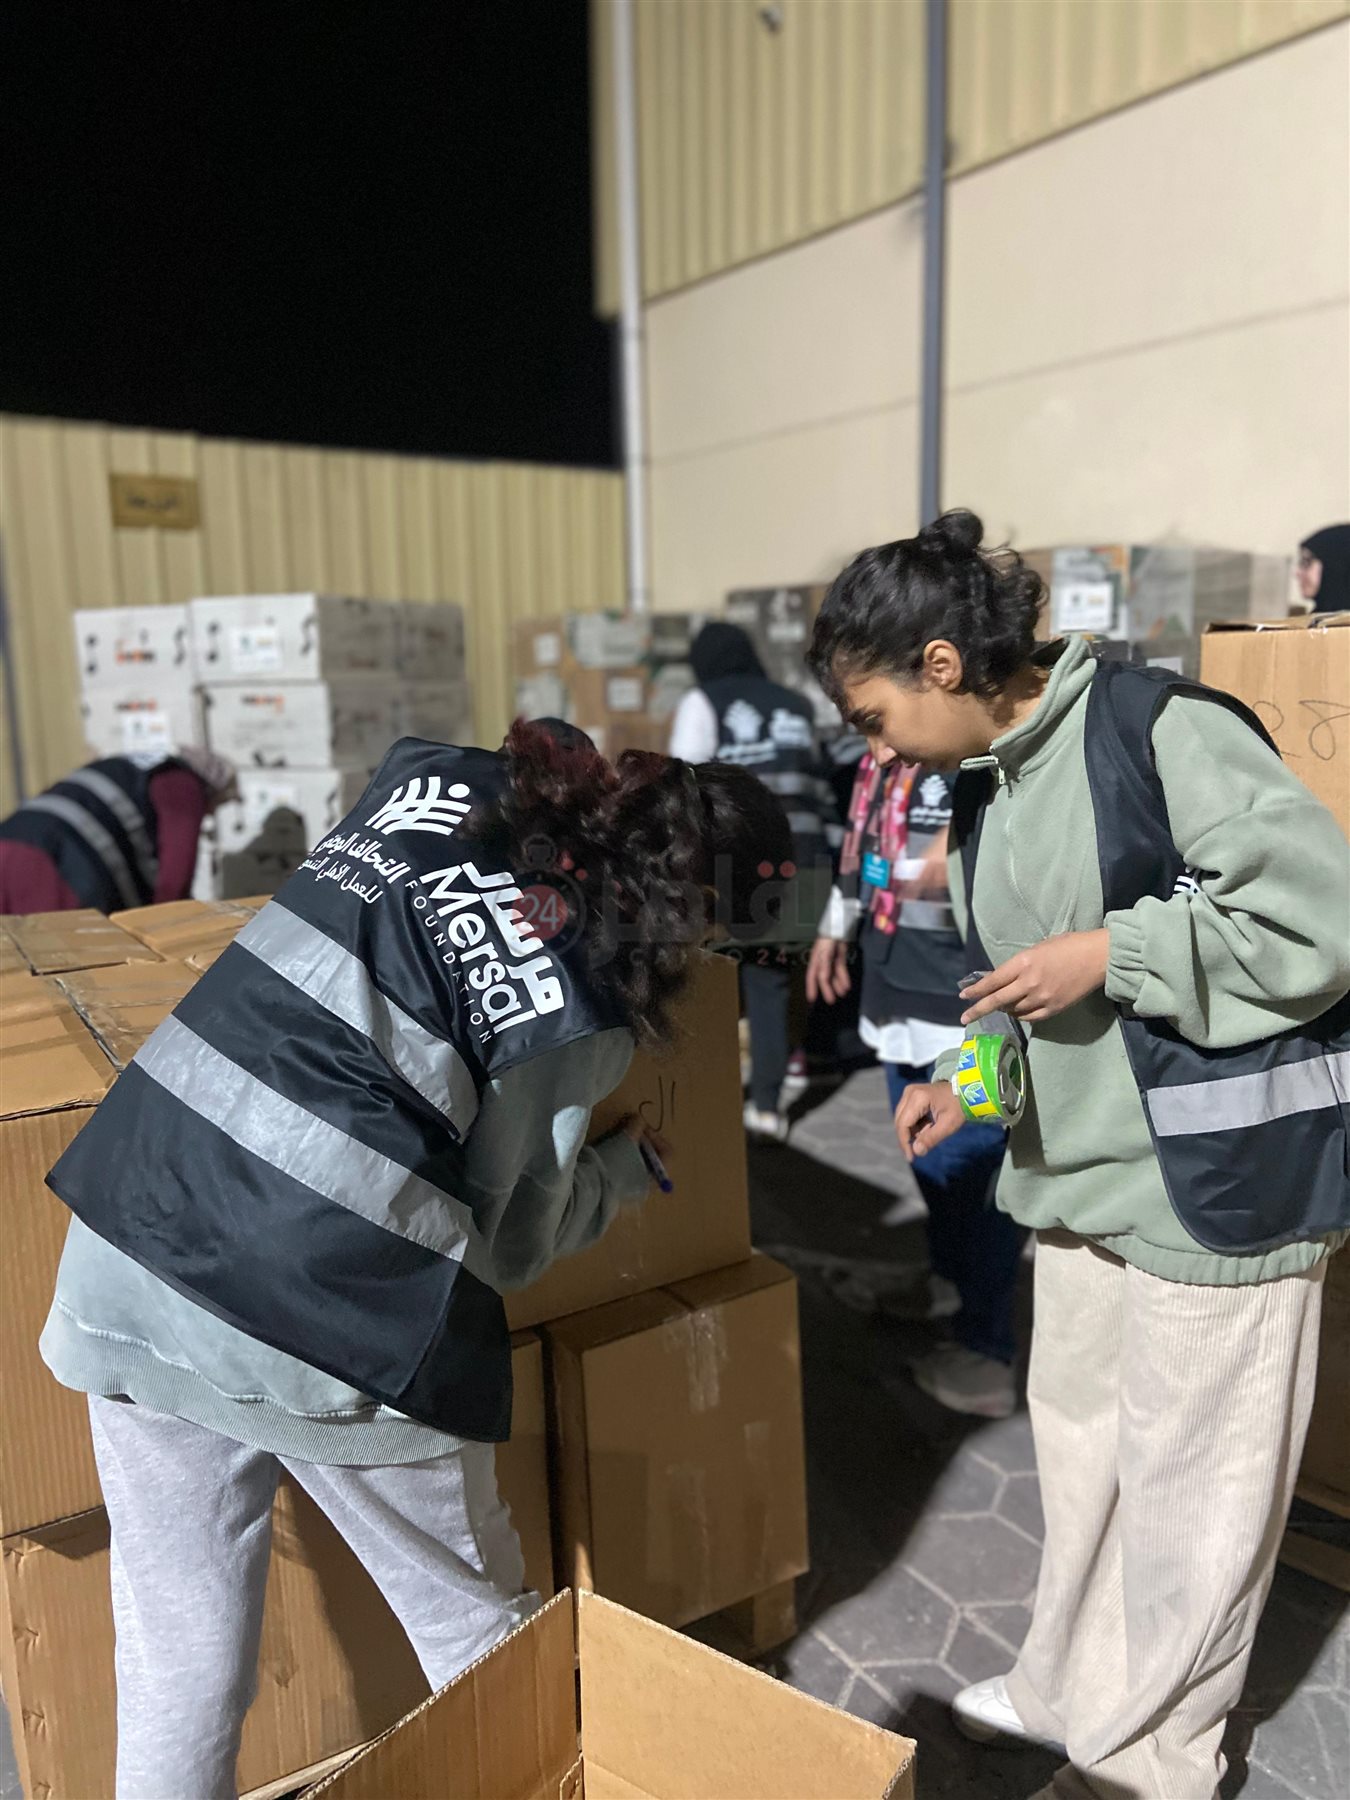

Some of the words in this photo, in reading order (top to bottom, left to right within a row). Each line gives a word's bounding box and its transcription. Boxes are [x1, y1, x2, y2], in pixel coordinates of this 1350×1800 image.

[315, 860, 351, 882] الأهلي
[347, 838, 411, 884] التحالف
[341, 871, 384, 904] للعمل
[405, 879, 492, 1044] FOUNDATION
[419, 864, 537, 1035] Mersal
